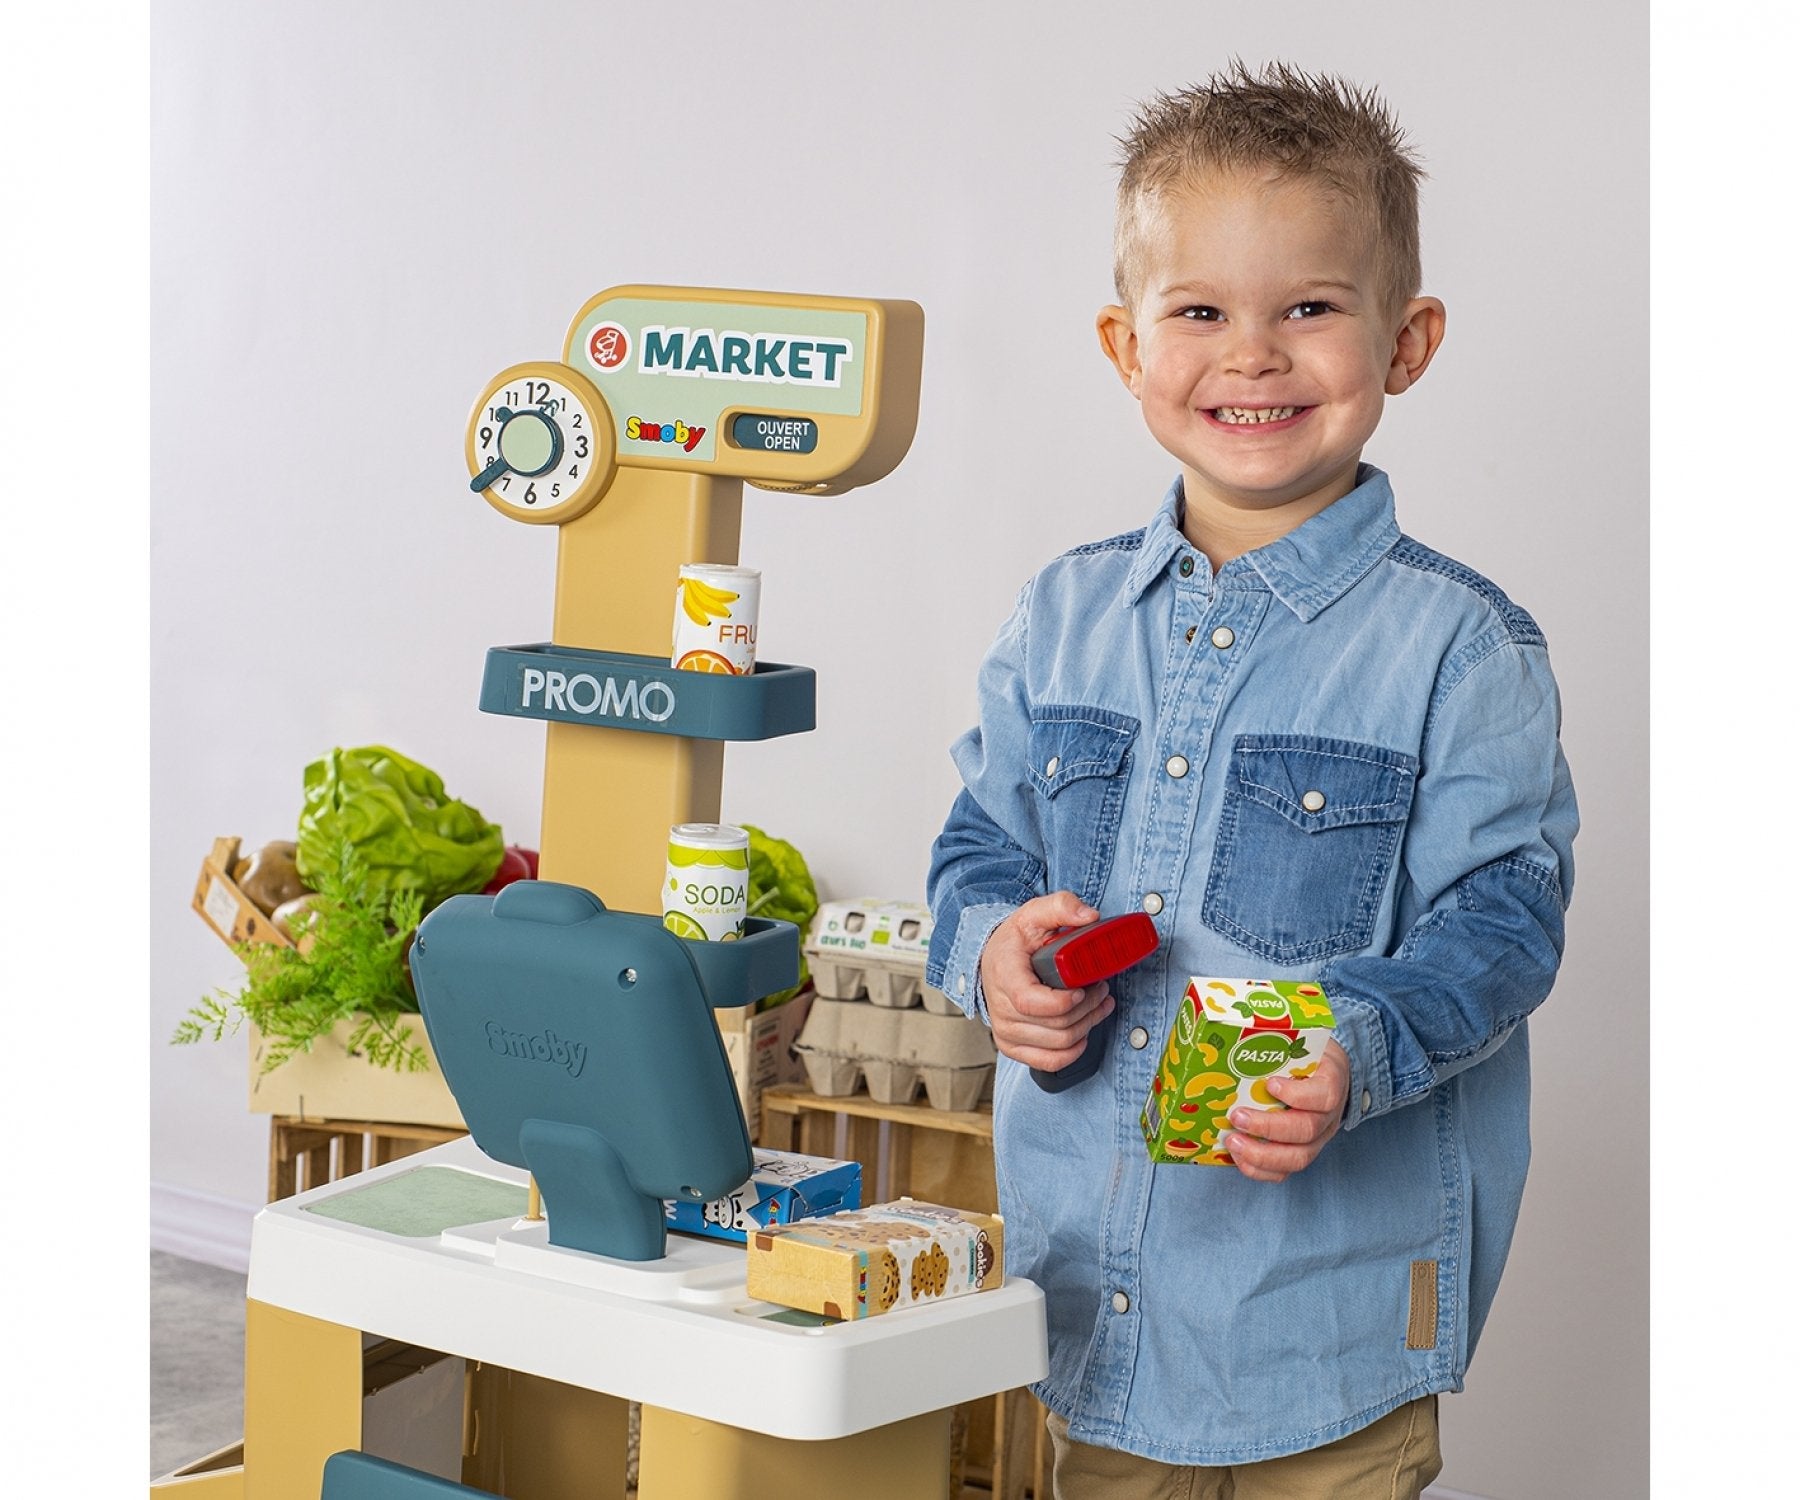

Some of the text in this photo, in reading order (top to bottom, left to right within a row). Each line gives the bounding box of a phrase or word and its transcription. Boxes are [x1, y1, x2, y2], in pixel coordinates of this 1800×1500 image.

[644, 331, 846, 381] MARKET
[505, 391, 519, 406] 11
[526, 382, 550, 405] 12
[560, 398, 566, 411] 1
[573, 414, 582, 428] 2
[757, 421, 810, 436] OUVERT
[480, 427, 493, 449] 9
[626, 416, 706, 452] Smoby
[574, 436, 588, 458] 3
[765, 436, 800, 450] OPEN
[569, 465, 578, 479] 4
[502, 478, 511, 491] 7
[551, 484, 560, 497] 5
[524, 482, 537, 504] 6
[522, 668, 675, 722] PROMO
[685, 883, 745, 905] SODA
[1249, 999, 1284, 1009] PASTA
[484, 1020, 588, 1079] Smoby
[1235, 1049, 1286, 1063] PASTA
